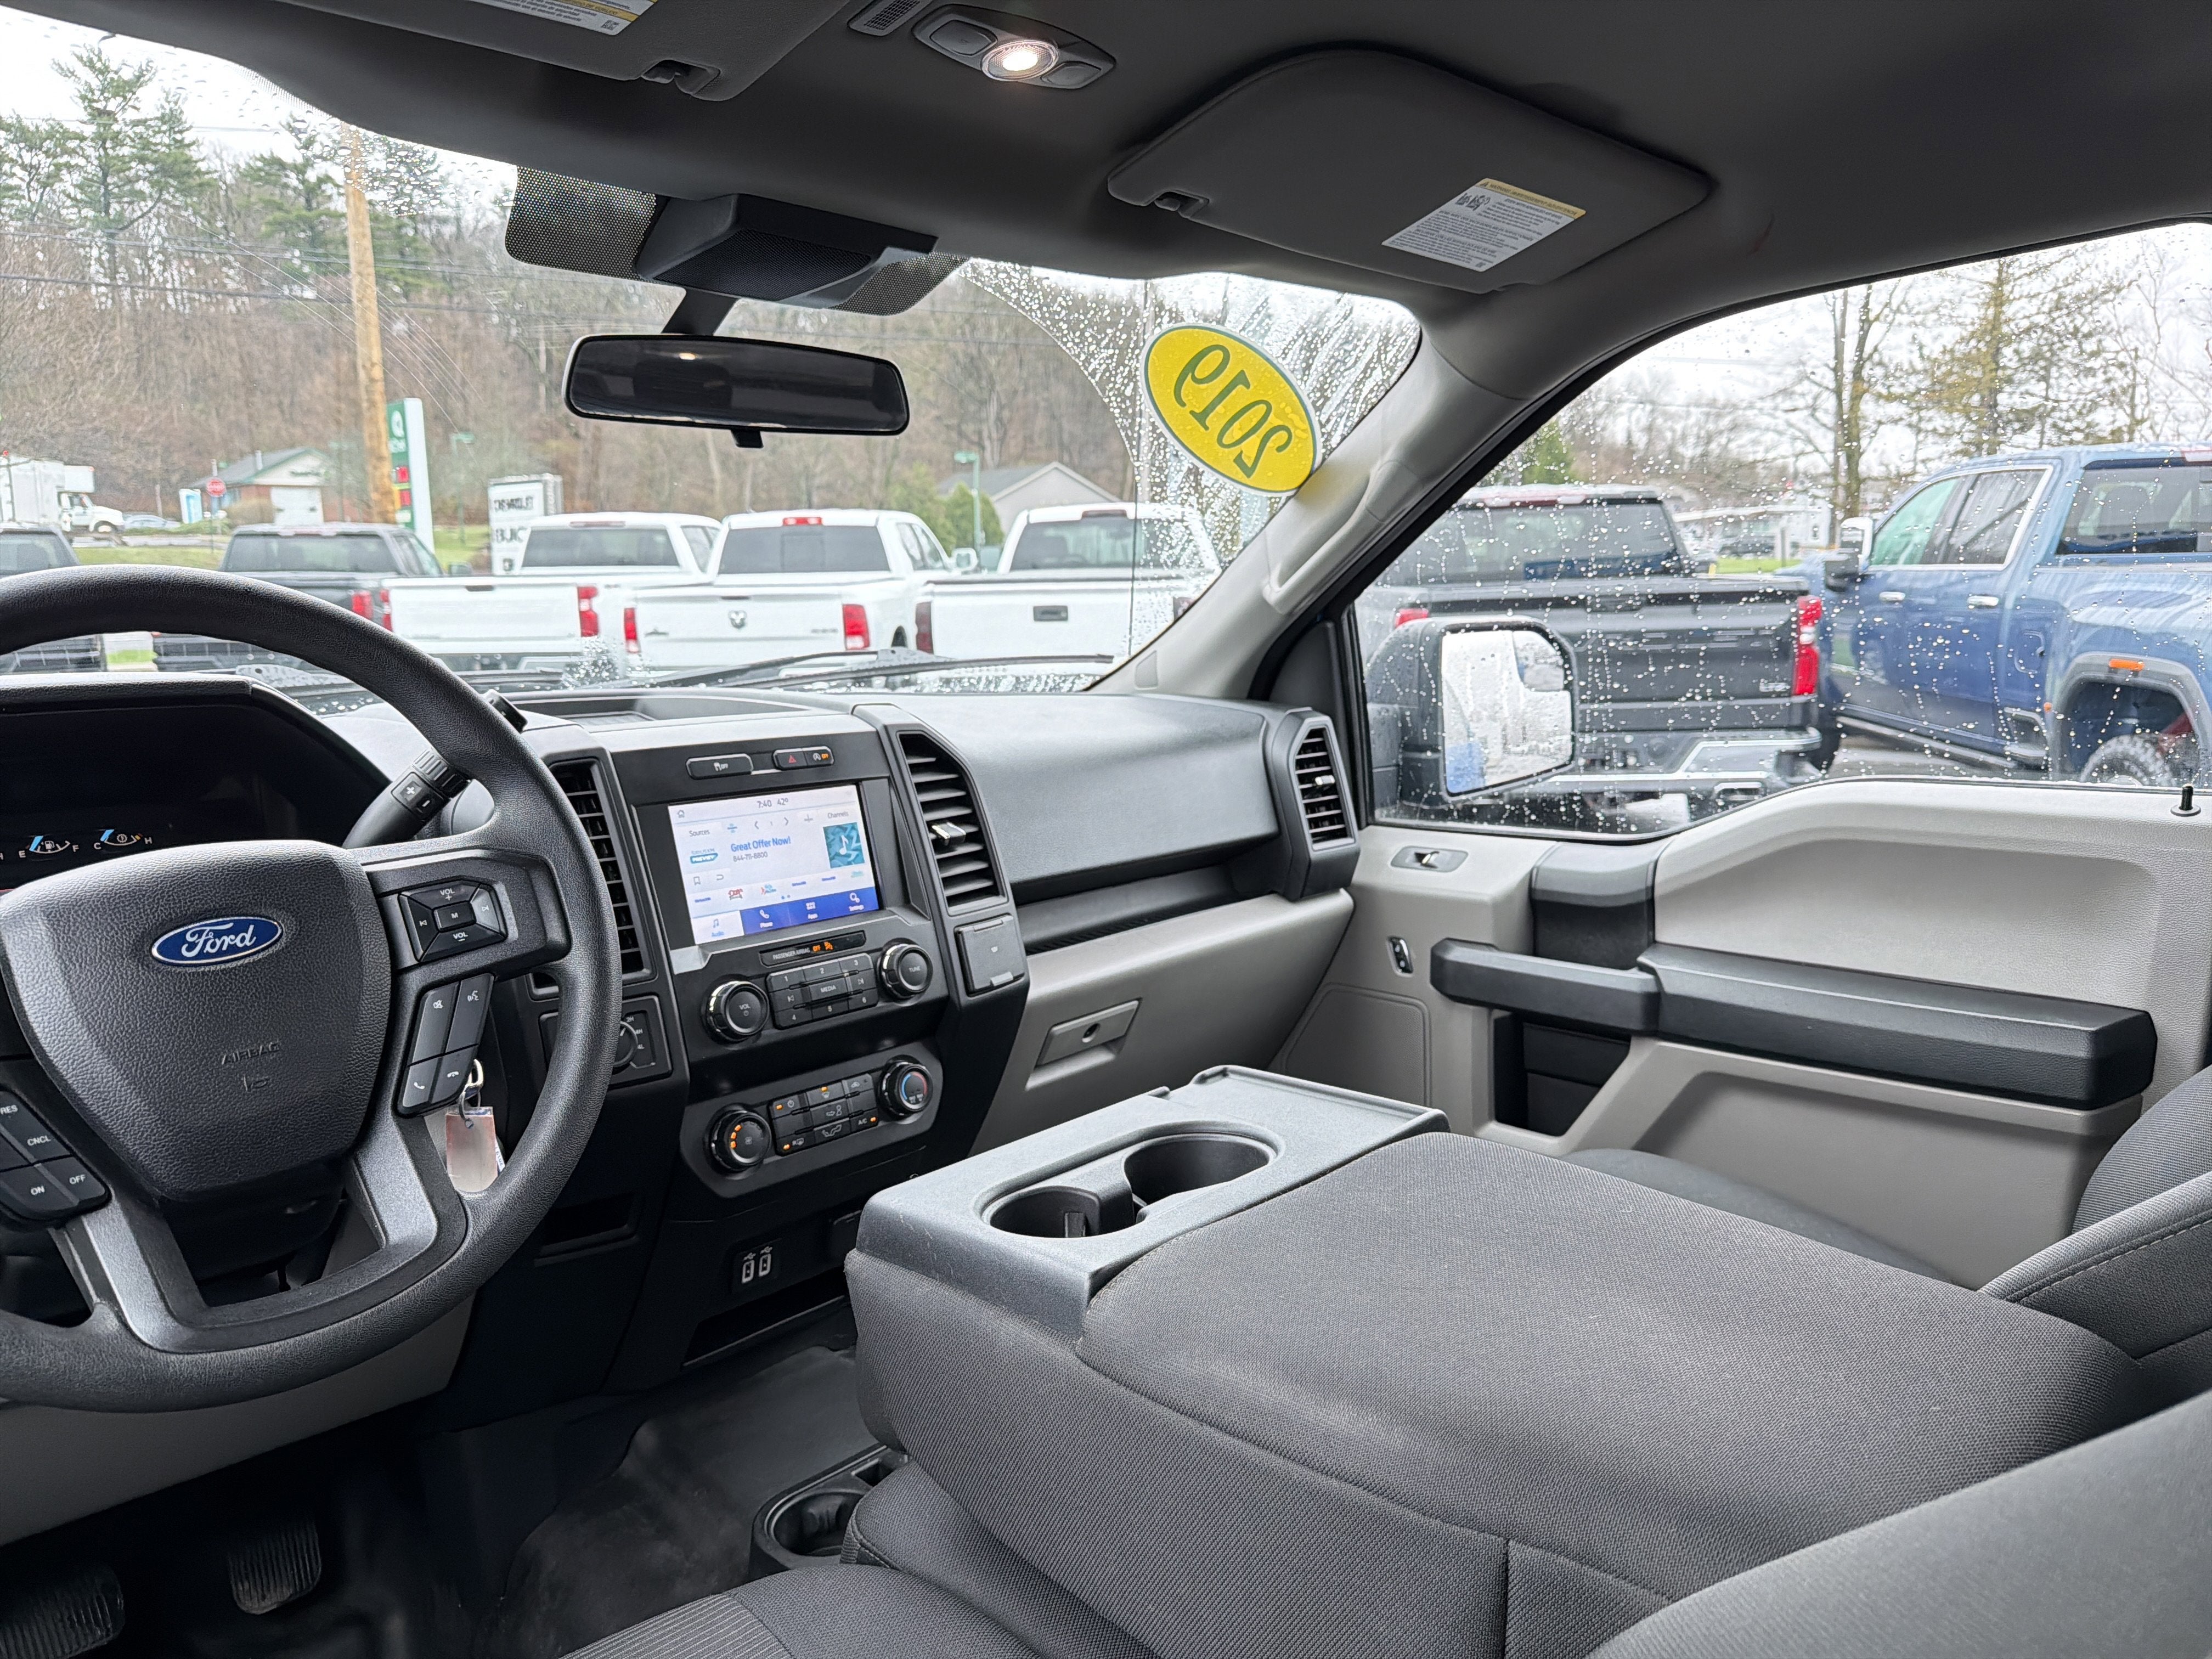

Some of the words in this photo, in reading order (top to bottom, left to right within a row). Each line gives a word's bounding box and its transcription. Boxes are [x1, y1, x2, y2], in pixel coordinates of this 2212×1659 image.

[757, 799, 772, 808] 7:40
[731, 842, 752, 852] Great
[753, 839, 771, 849] Offer
[772, 836, 791, 847] Now!
[181, 922, 256, 957] Ford
[772, 950, 795, 960] PASSENGER
[221, 1042, 280, 1065] AIRBAG
[0, 1105, 18, 1115] RES
[27, 1135, 51, 1146] CNCL
[69, 1174, 86, 1185] OFF
[31, 1186, 45, 1196] ON
